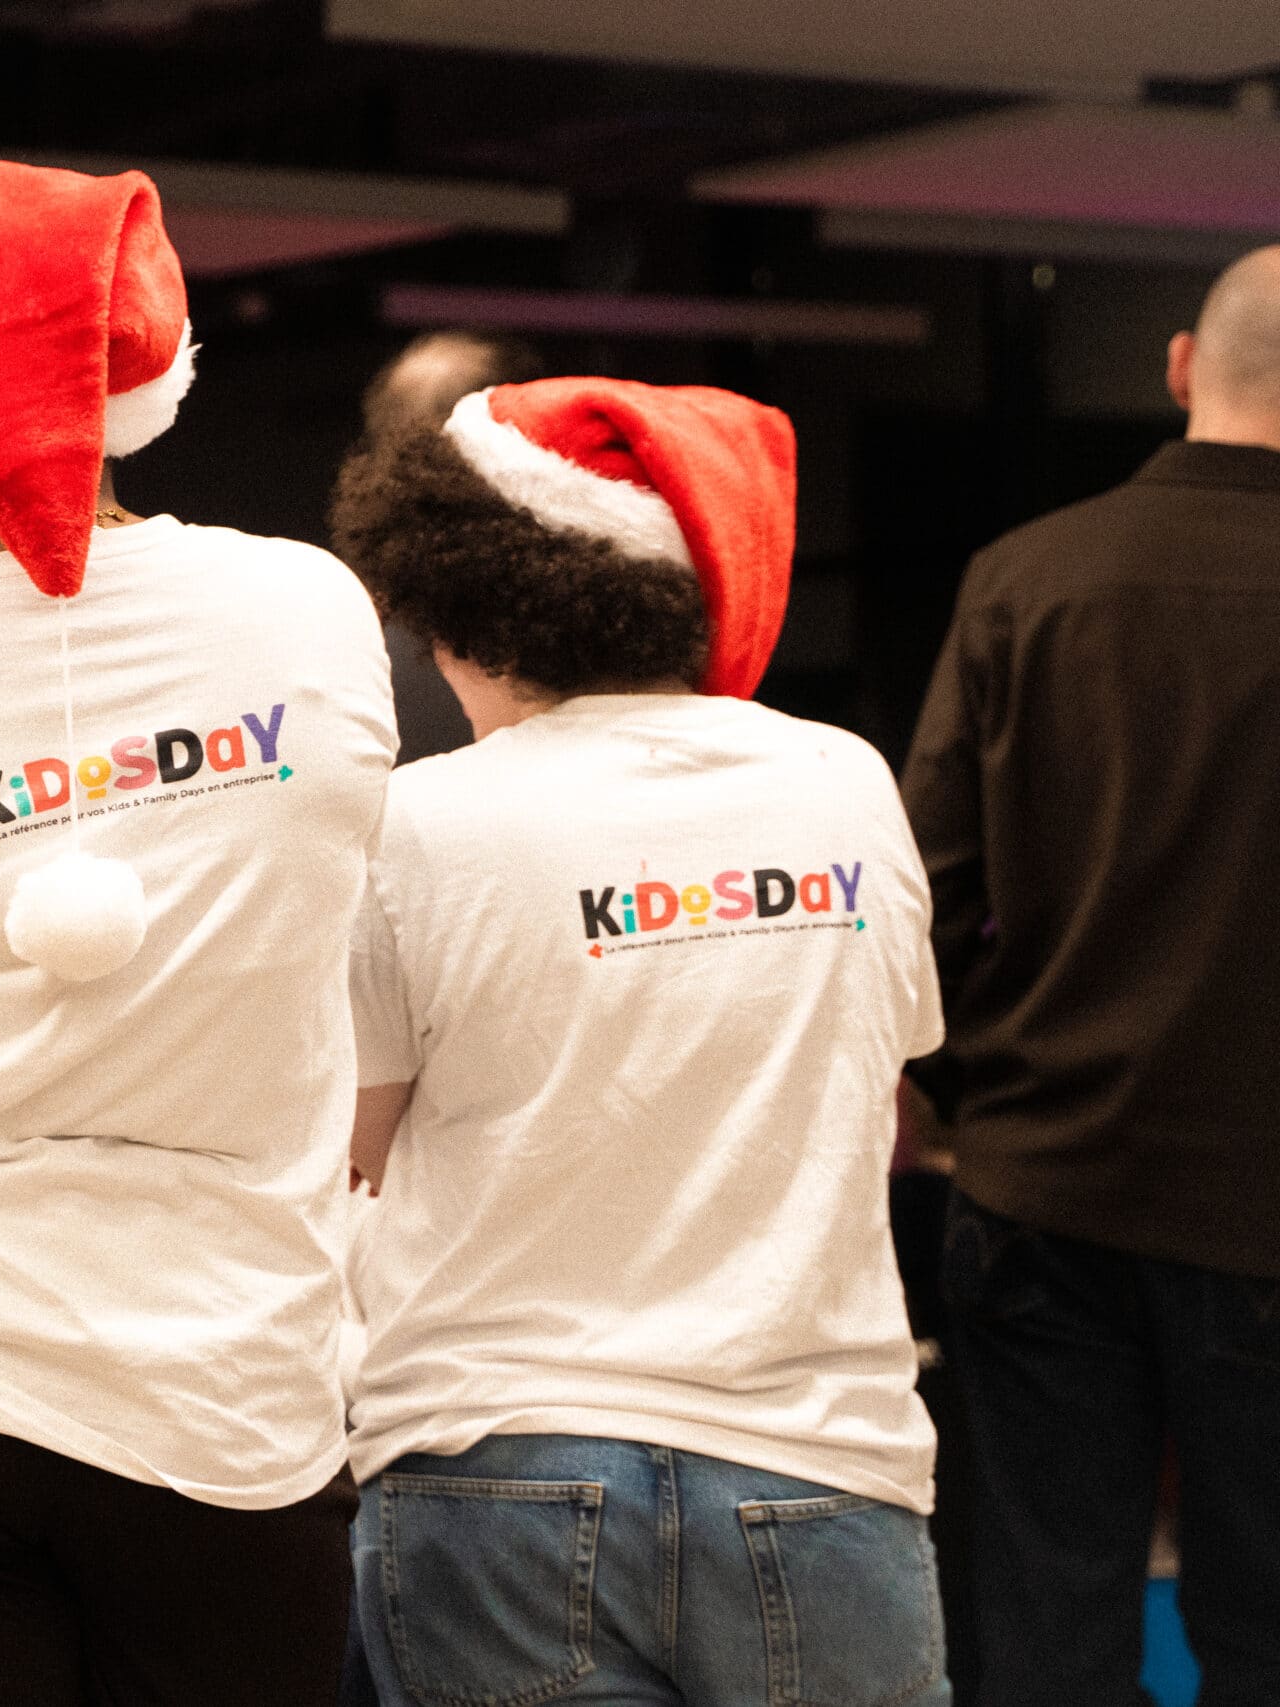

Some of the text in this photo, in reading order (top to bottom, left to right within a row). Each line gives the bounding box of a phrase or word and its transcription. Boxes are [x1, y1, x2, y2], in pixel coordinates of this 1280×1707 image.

[10, 817, 58, 837] référence
[87, 808, 105, 818] vos
[108, 799, 130, 812] Kids
[133, 799, 141, 807] &
[143, 791, 178, 805] Family
[180, 786, 205, 799] Days
[208, 783, 221, 792] en
[223, 772, 275, 790] entreprise
